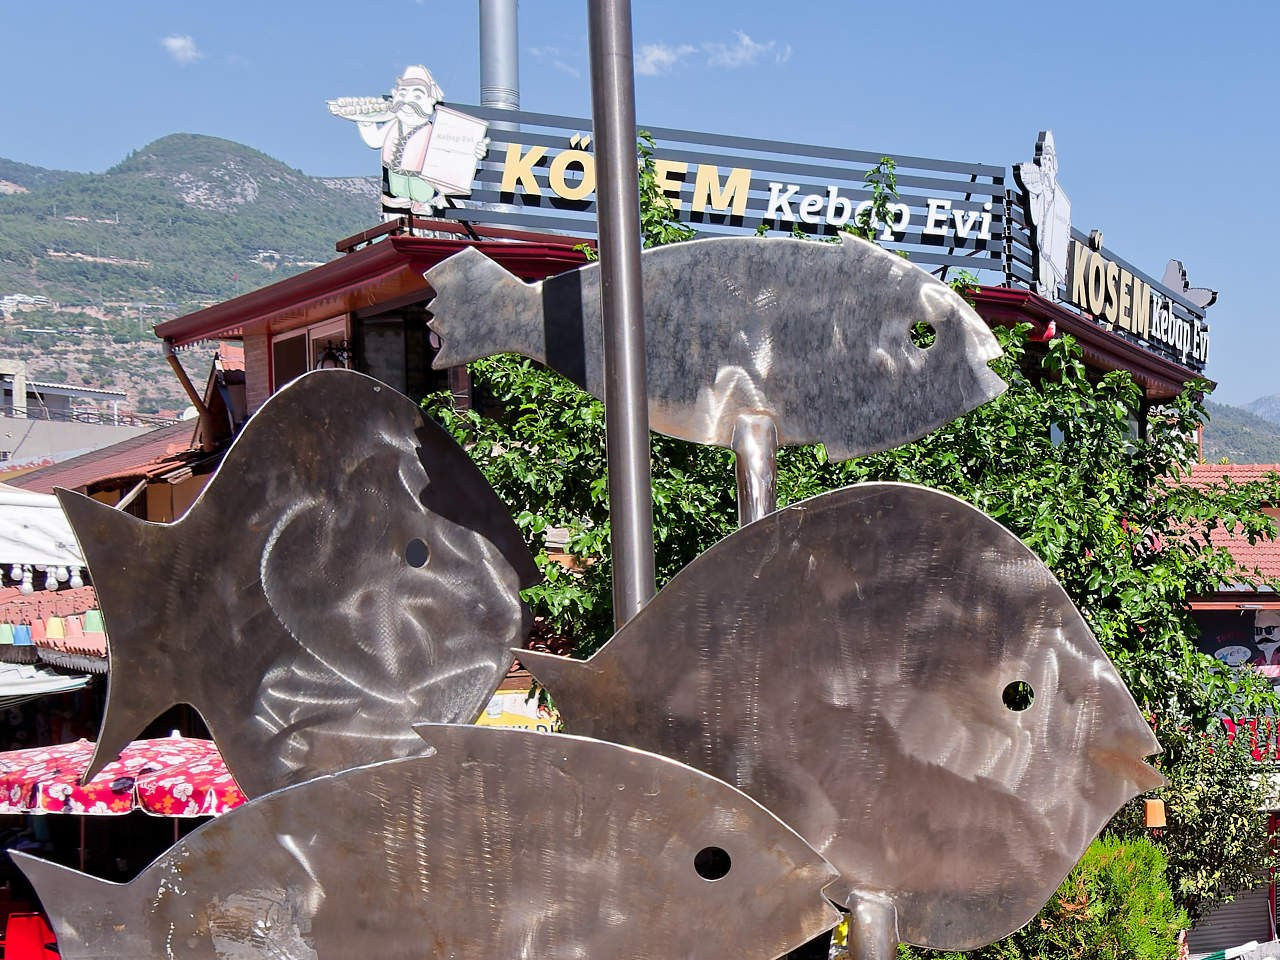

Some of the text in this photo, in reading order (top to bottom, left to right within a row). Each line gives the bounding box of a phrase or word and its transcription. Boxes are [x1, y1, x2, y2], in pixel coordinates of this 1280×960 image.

[501, 133, 994, 242] KÖEM Kebap Evi
[1072, 229, 1211, 364] KÖŞEM Kebap Evi
